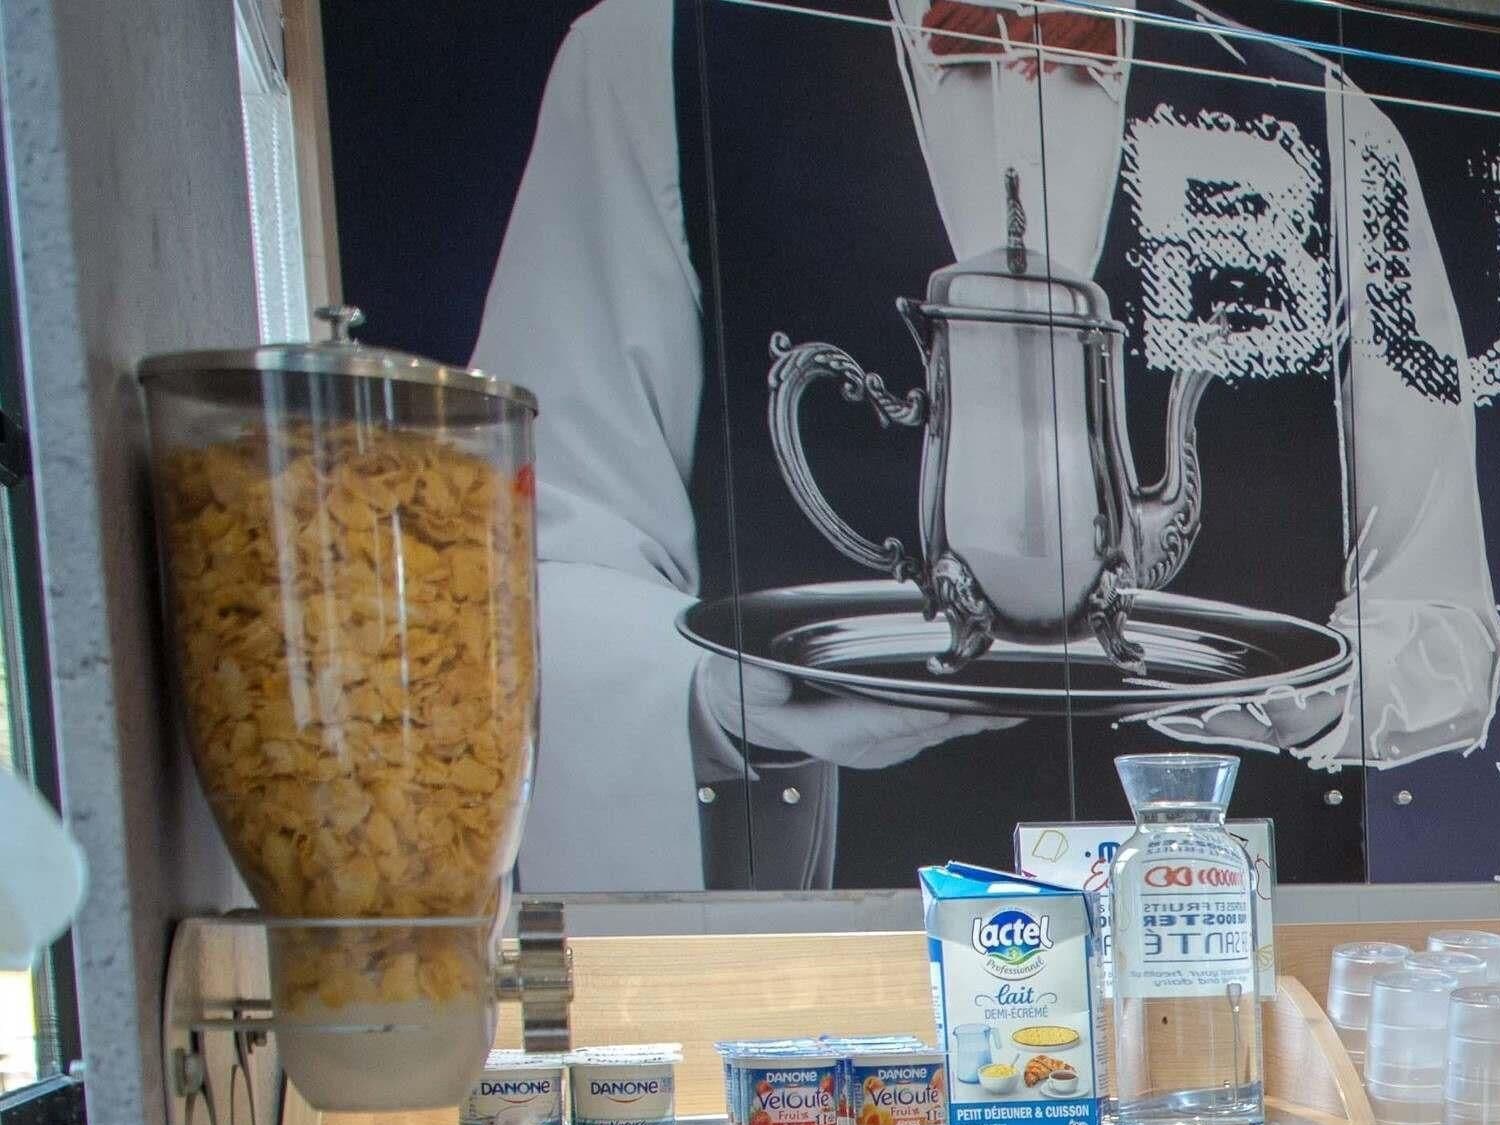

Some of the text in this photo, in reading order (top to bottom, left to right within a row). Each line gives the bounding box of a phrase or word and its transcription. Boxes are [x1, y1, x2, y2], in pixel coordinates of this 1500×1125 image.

[972, 914, 1054, 955] lactel
[995, 983, 1034, 1005] lait
[957, 1104, 1090, 1121] PETIT DÉJEUNER & CUISSON
